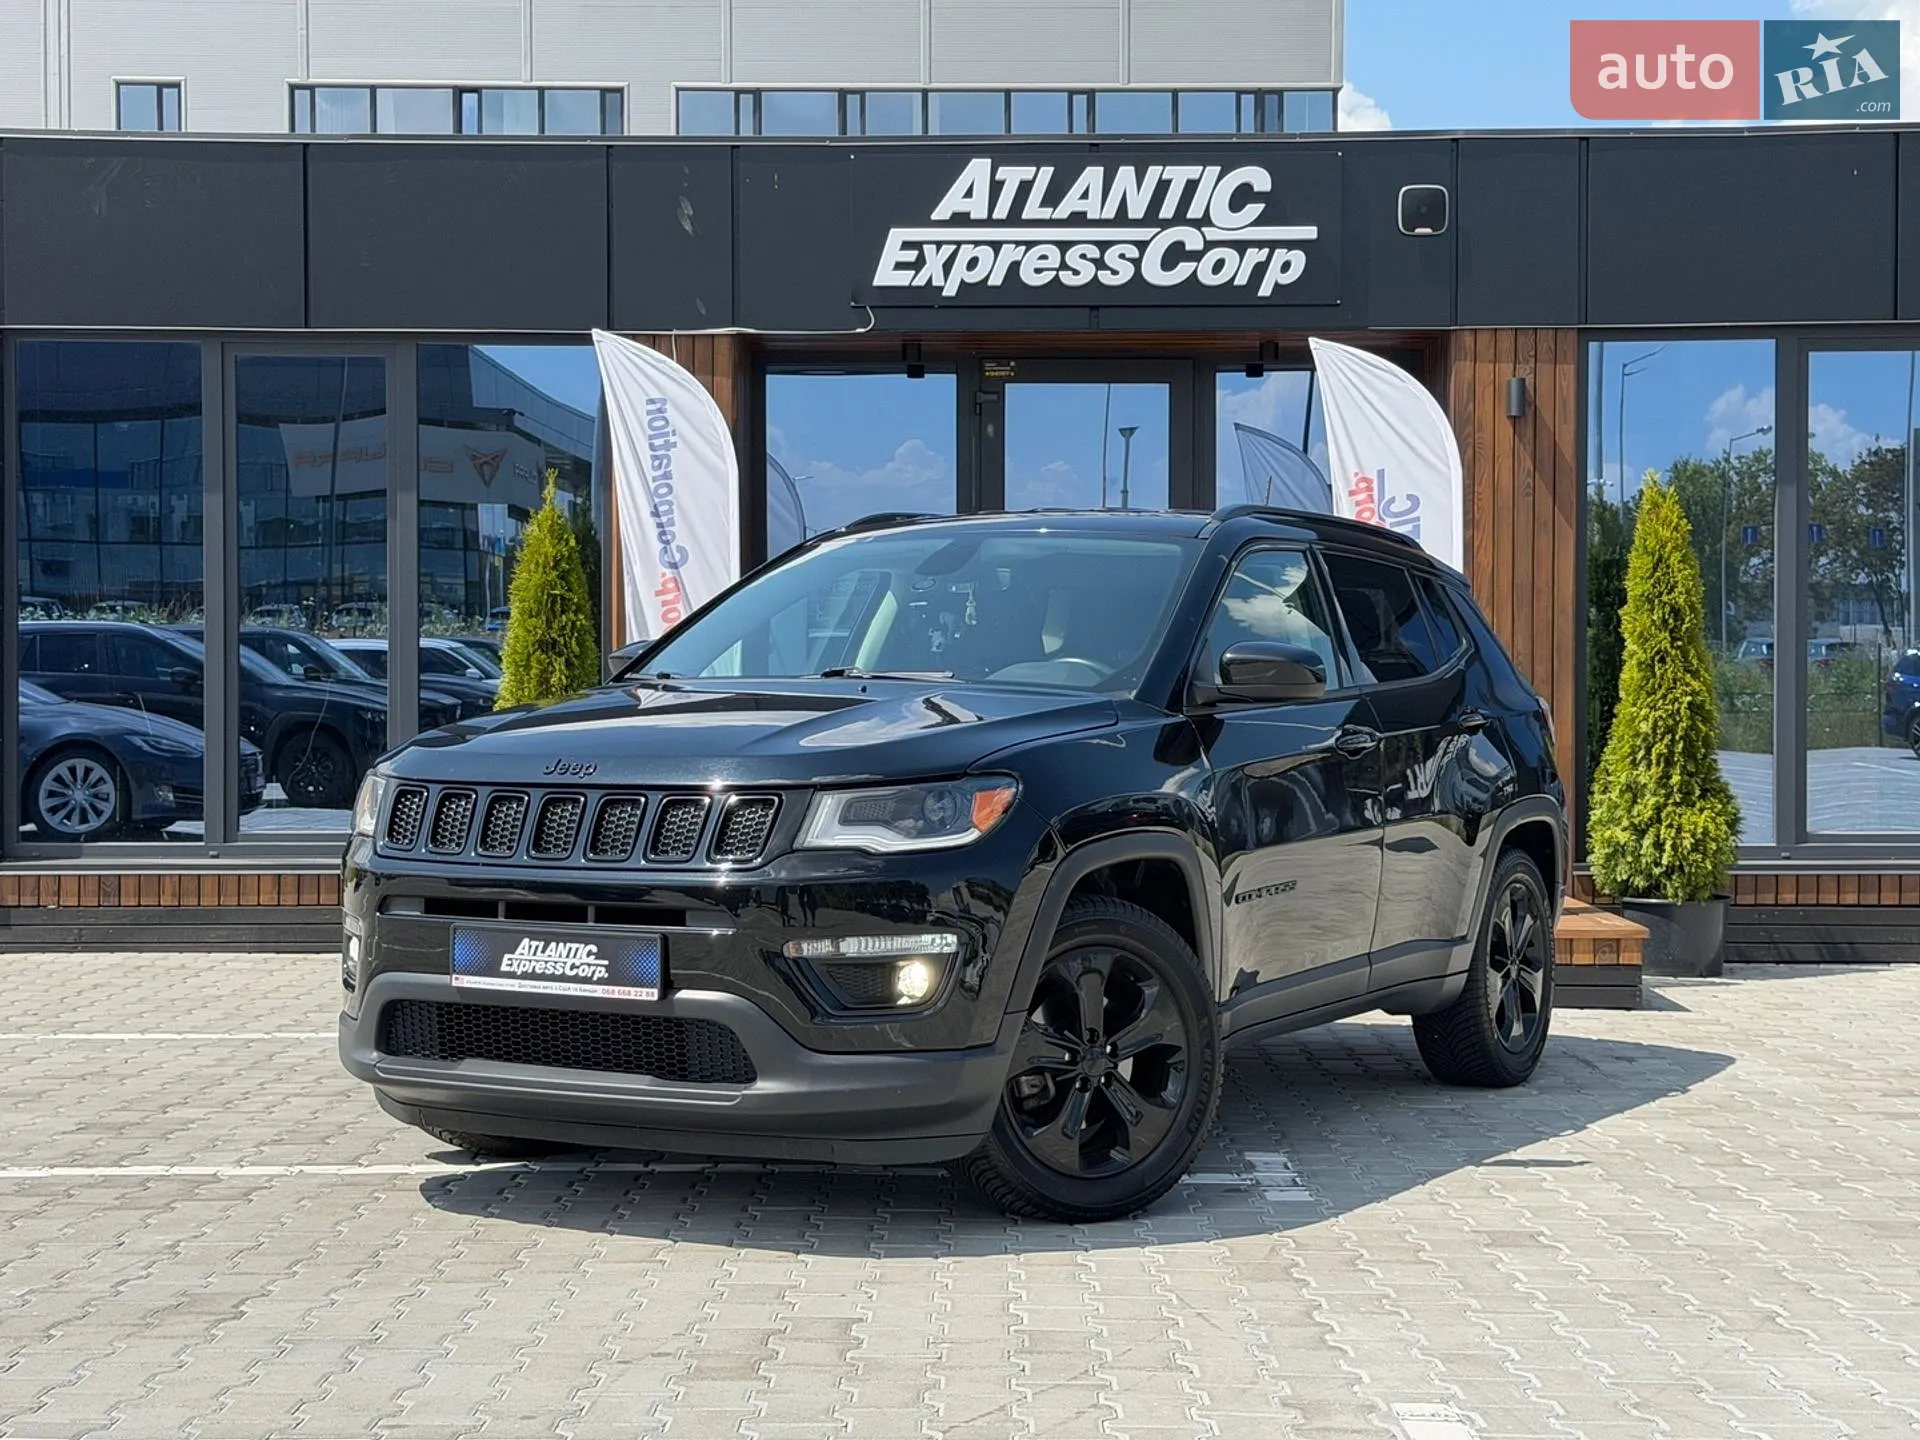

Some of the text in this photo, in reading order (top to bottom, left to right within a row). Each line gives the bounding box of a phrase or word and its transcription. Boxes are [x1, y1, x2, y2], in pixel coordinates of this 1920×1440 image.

[931, 158, 1272, 228] ATLANTIC
[873, 226, 1306, 297] ExpressCorp
[543, 758, 597, 779] Jeep
[515, 938, 598, 961] ATLANTIC
[500, 954, 609, 981] ExpressCorp.
